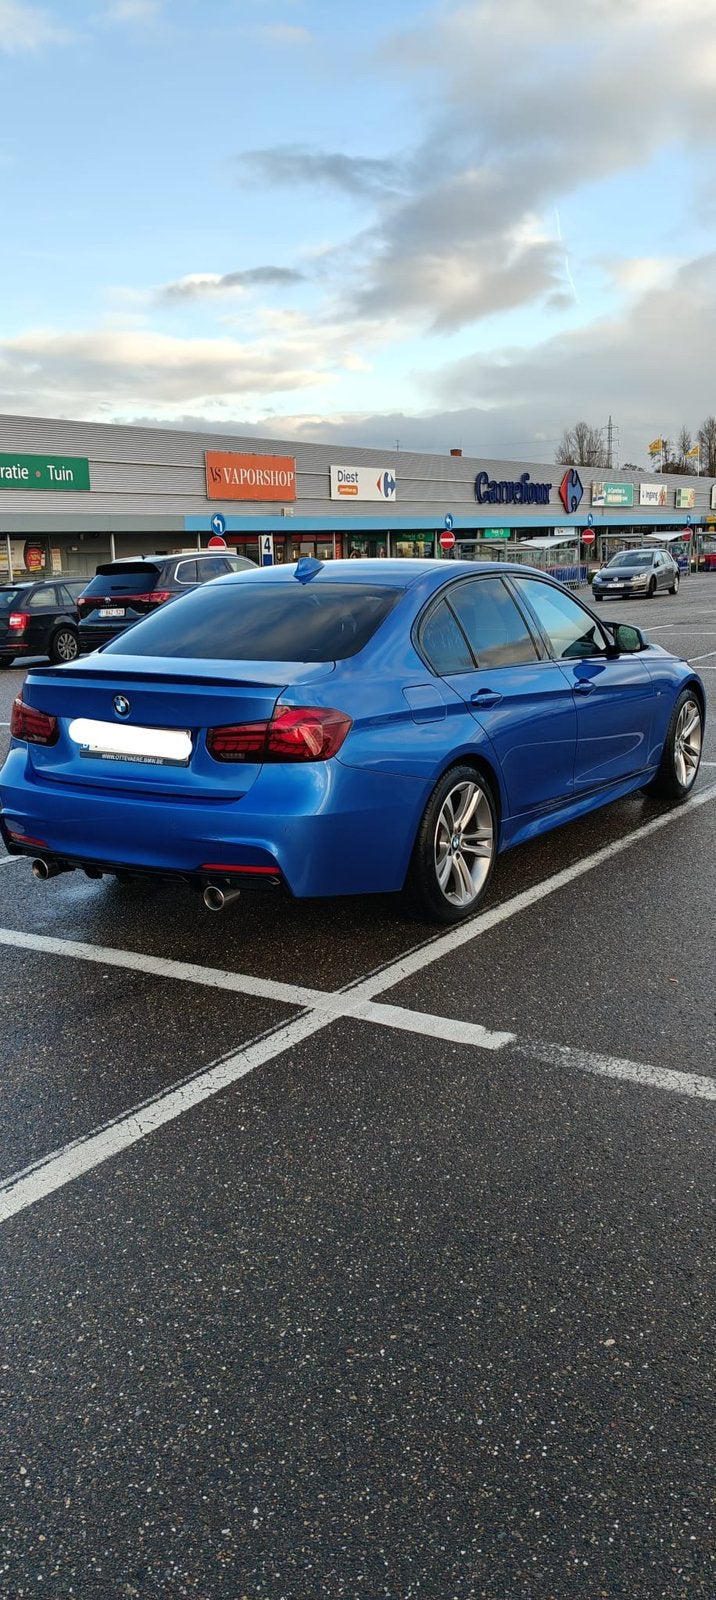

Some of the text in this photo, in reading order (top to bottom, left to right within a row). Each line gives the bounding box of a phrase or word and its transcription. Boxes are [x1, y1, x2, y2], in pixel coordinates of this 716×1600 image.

[46, 464, 74, 481] Tuin
[223, 467, 294, 487] VAPORSHOP
[337, 469, 359, 483] Diest
[474, 471, 552, 505] Carrefour
[263, 536, 272, 553] 4
